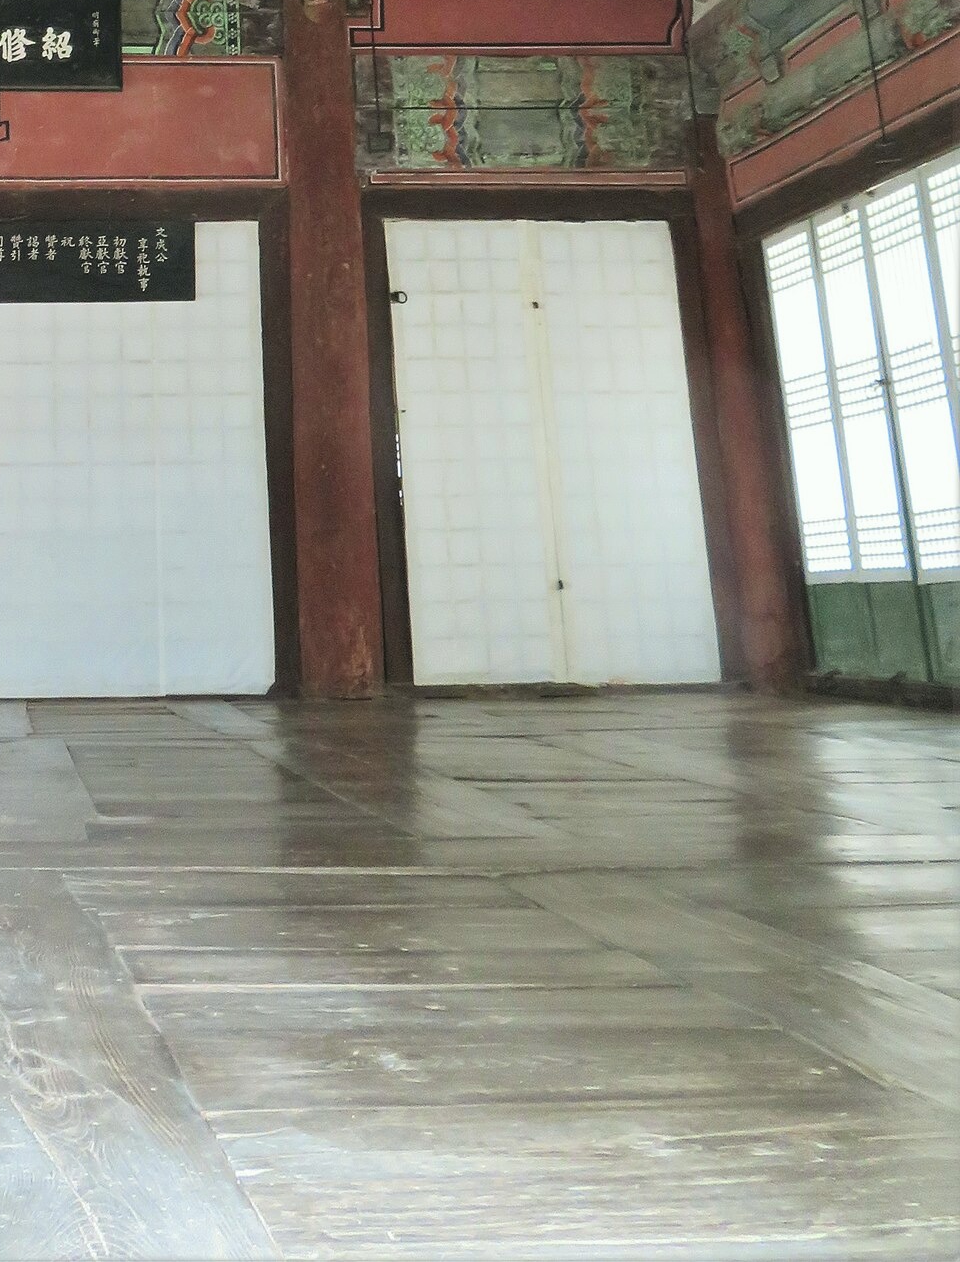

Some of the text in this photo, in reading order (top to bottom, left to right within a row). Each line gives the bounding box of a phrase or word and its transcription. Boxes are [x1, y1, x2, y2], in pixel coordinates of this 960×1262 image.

[27, 236, 40, 261] 謁者
[61, 236, 76, 248] 祝
[78, 235, 93, 274] 終獻官
[95, 235, 110, 274] 亞獻官
[113, 236, 129, 274] 初獻官
[155, 227, 168, 263] 文成公
